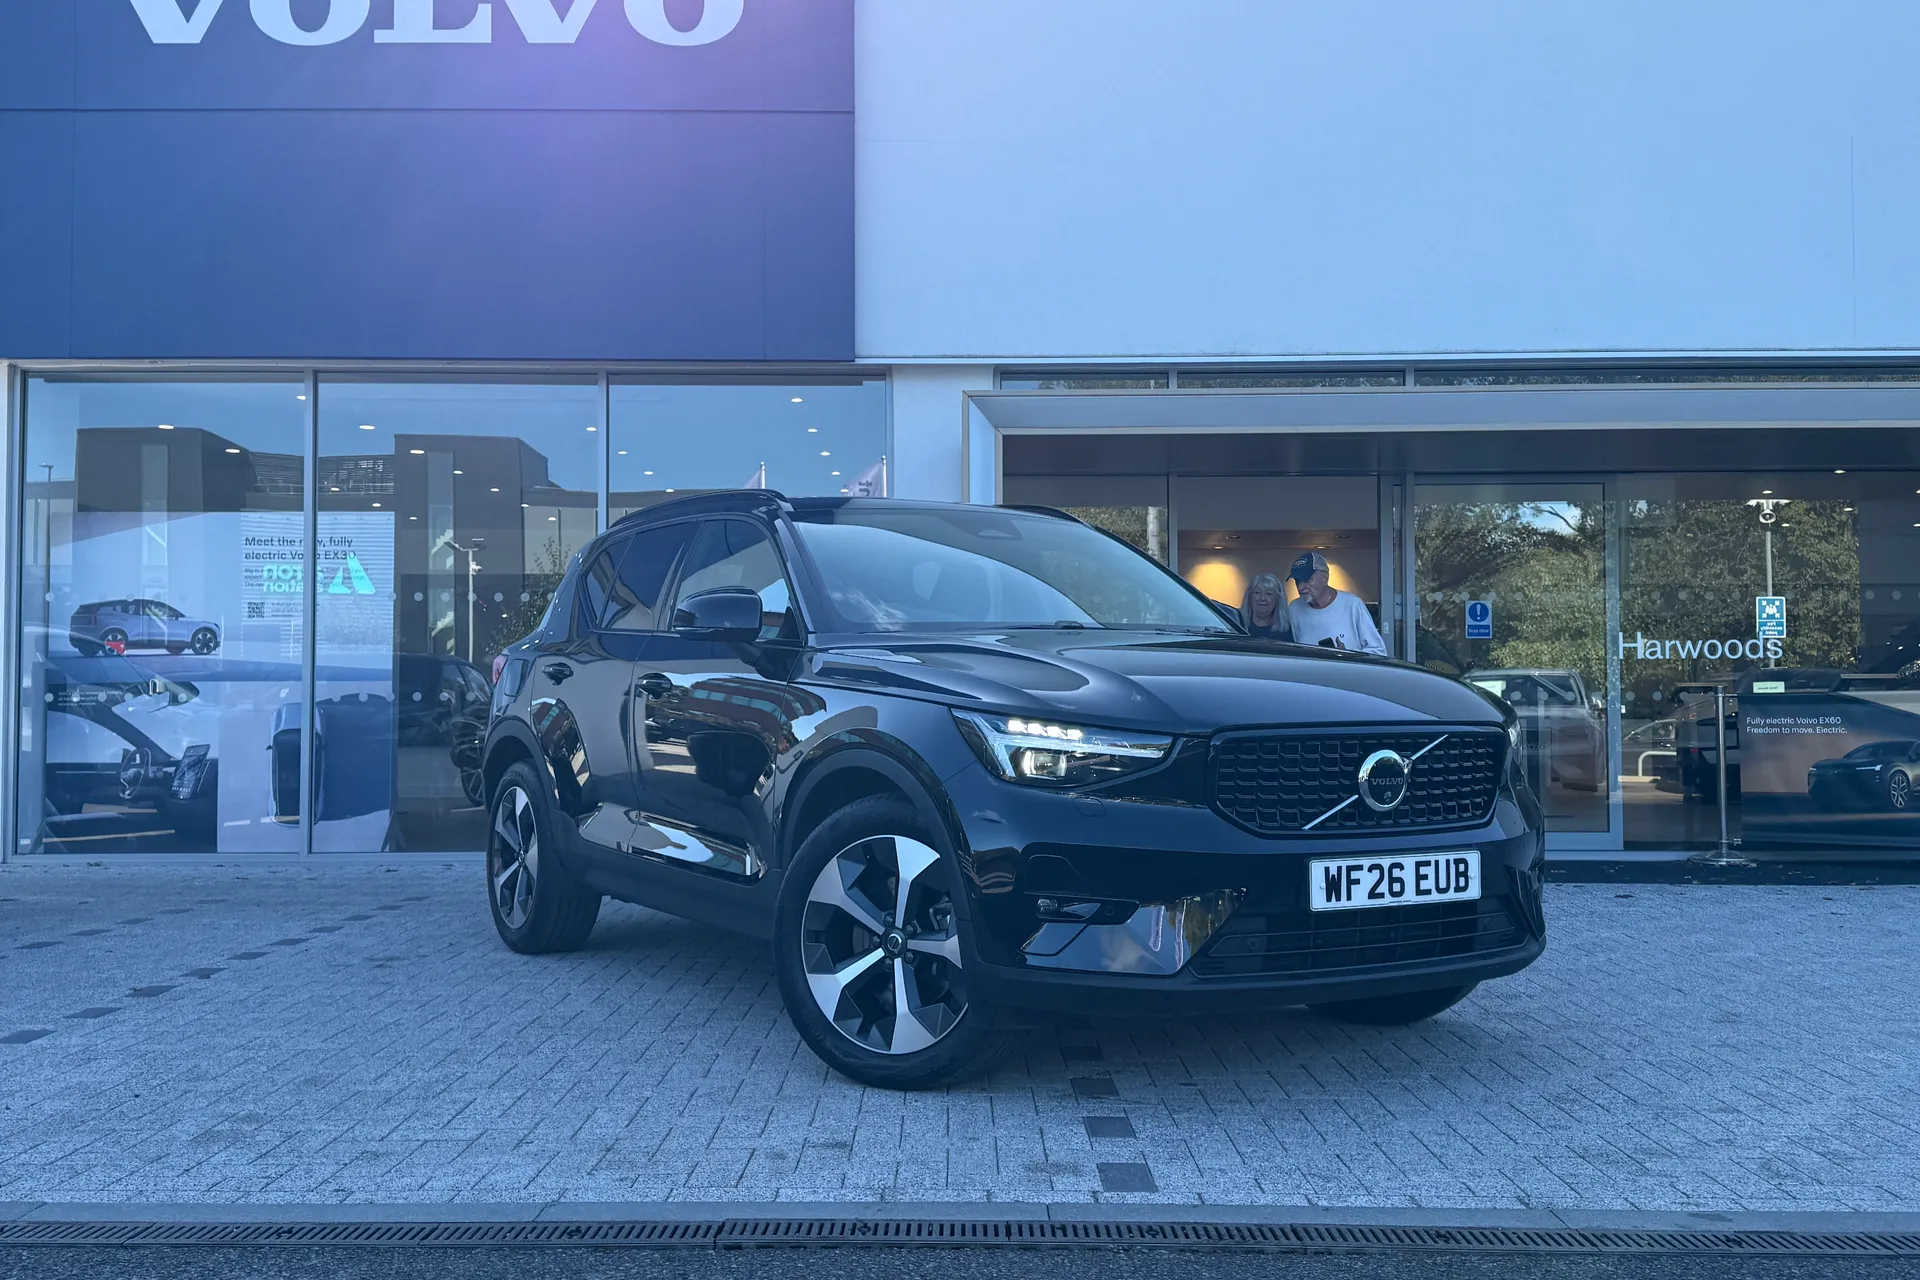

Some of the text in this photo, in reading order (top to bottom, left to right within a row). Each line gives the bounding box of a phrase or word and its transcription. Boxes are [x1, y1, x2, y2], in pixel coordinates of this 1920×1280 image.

[245, 536, 274, 547] Meet
[277, 536, 296, 547] the
[329, 536, 353, 548] fully
[244, 550, 287, 560] electric
[324, 550, 357, 560] EX30
[1618, 631, 1783, 660] Harwoods
[1746, 716, 1842, 726] Fully electric Volvo EX60
[1746, 726, 1781, 734] Freedom
[1782, 726, 1790, 734] to
[1816, 726, 1848, 734] Electric.
[1370, 777, 1404, 786] VOLVO
[1324, 858, 1469, 902] WF26 EUB
